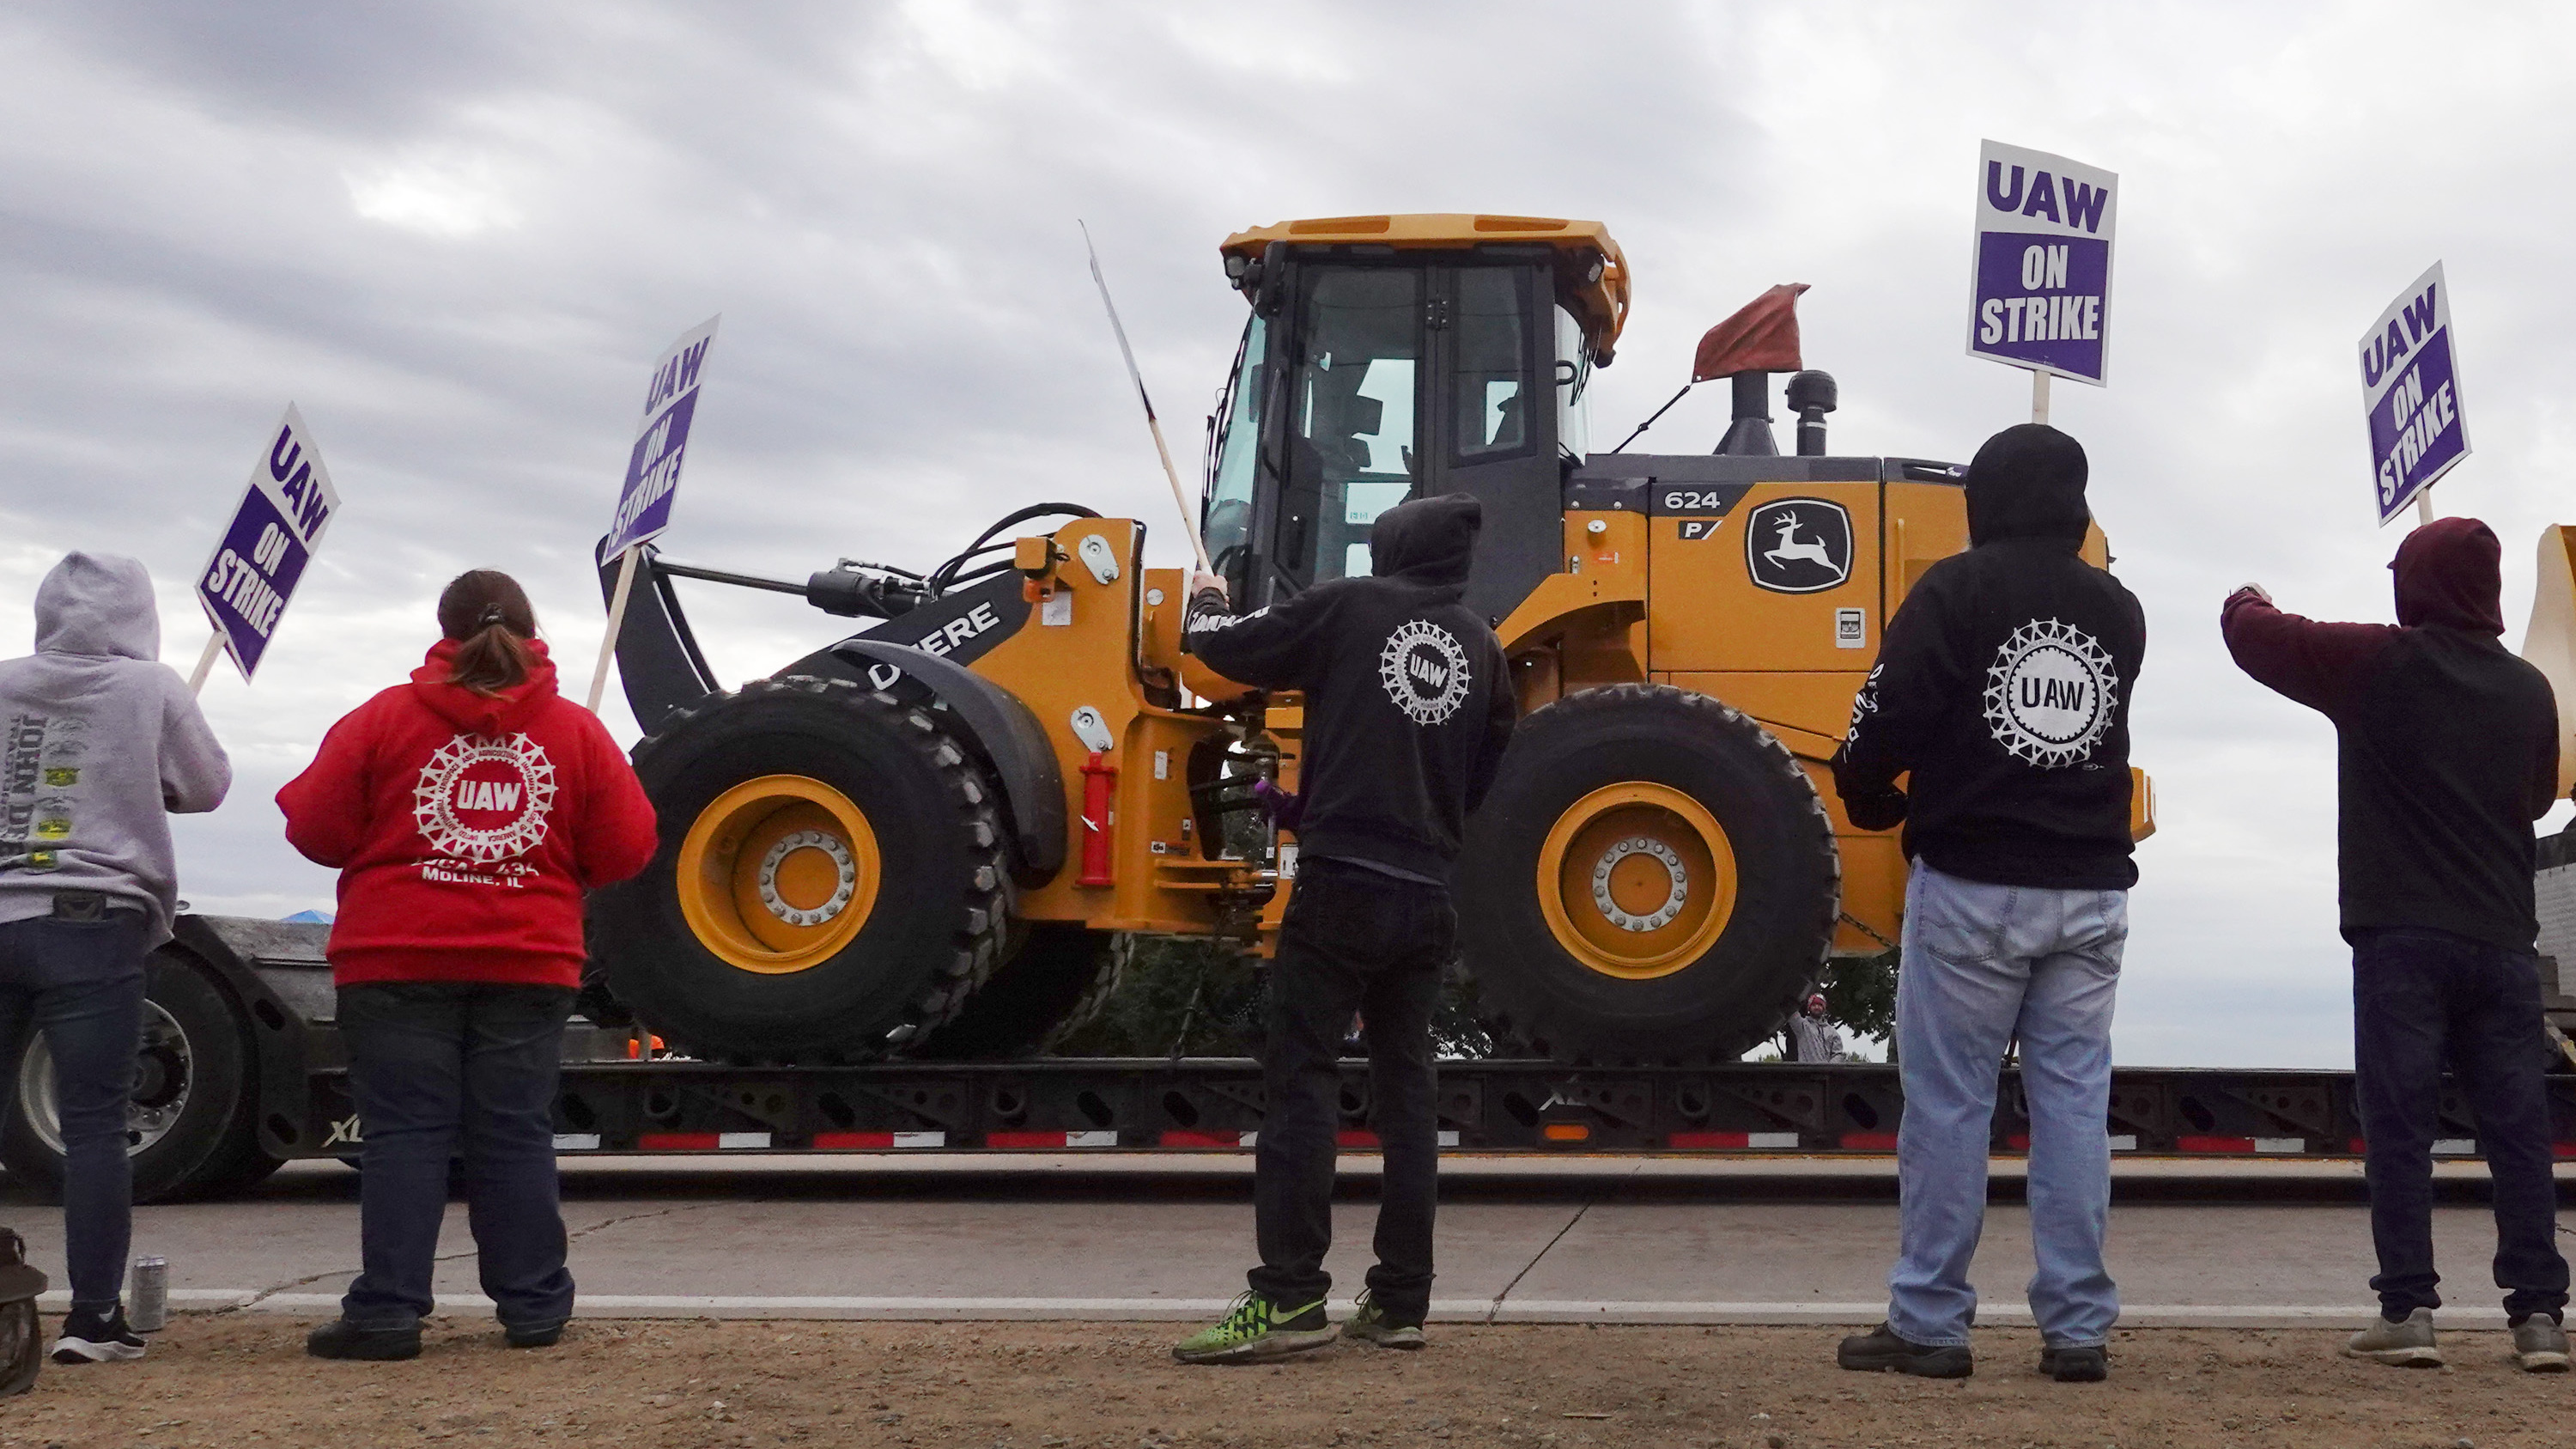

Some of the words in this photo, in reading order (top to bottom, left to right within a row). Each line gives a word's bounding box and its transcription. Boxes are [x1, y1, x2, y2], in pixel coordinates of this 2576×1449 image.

[1987, 160, 2108, 234] UAW
[2021, 245, 2069, 290] ON
[1980, 295, 2099, 344] STRIKE
[2363, 282, 2436, 387] UAW
[646, 335, 711, 416] UAW
[2392, 362, 2423, 431] ON
[641, 411, 674, 477] ON
[2379, 379, 2455, 506] STRIKE
[270, 423, 330, 544] UAW
[611, 443, 683, 548] STRIKE
[1664, 490, 1721, 509] 624
[253, 521, 291, 577] ON
[1684, 522, 1703, 538] P
[208, 548, 283, 638] STRIKE
[867, 601, 1000, 691] DERE
[1410, 653, 1449, 688] UAW
[2020, 677, 2085, 712] UAW
[11, 713, 49, 795] JOHN
[456, 780, 521, 811] UAW
[507, 876, 525, 889] IL
[321, 1112, 364, 1148] XL
